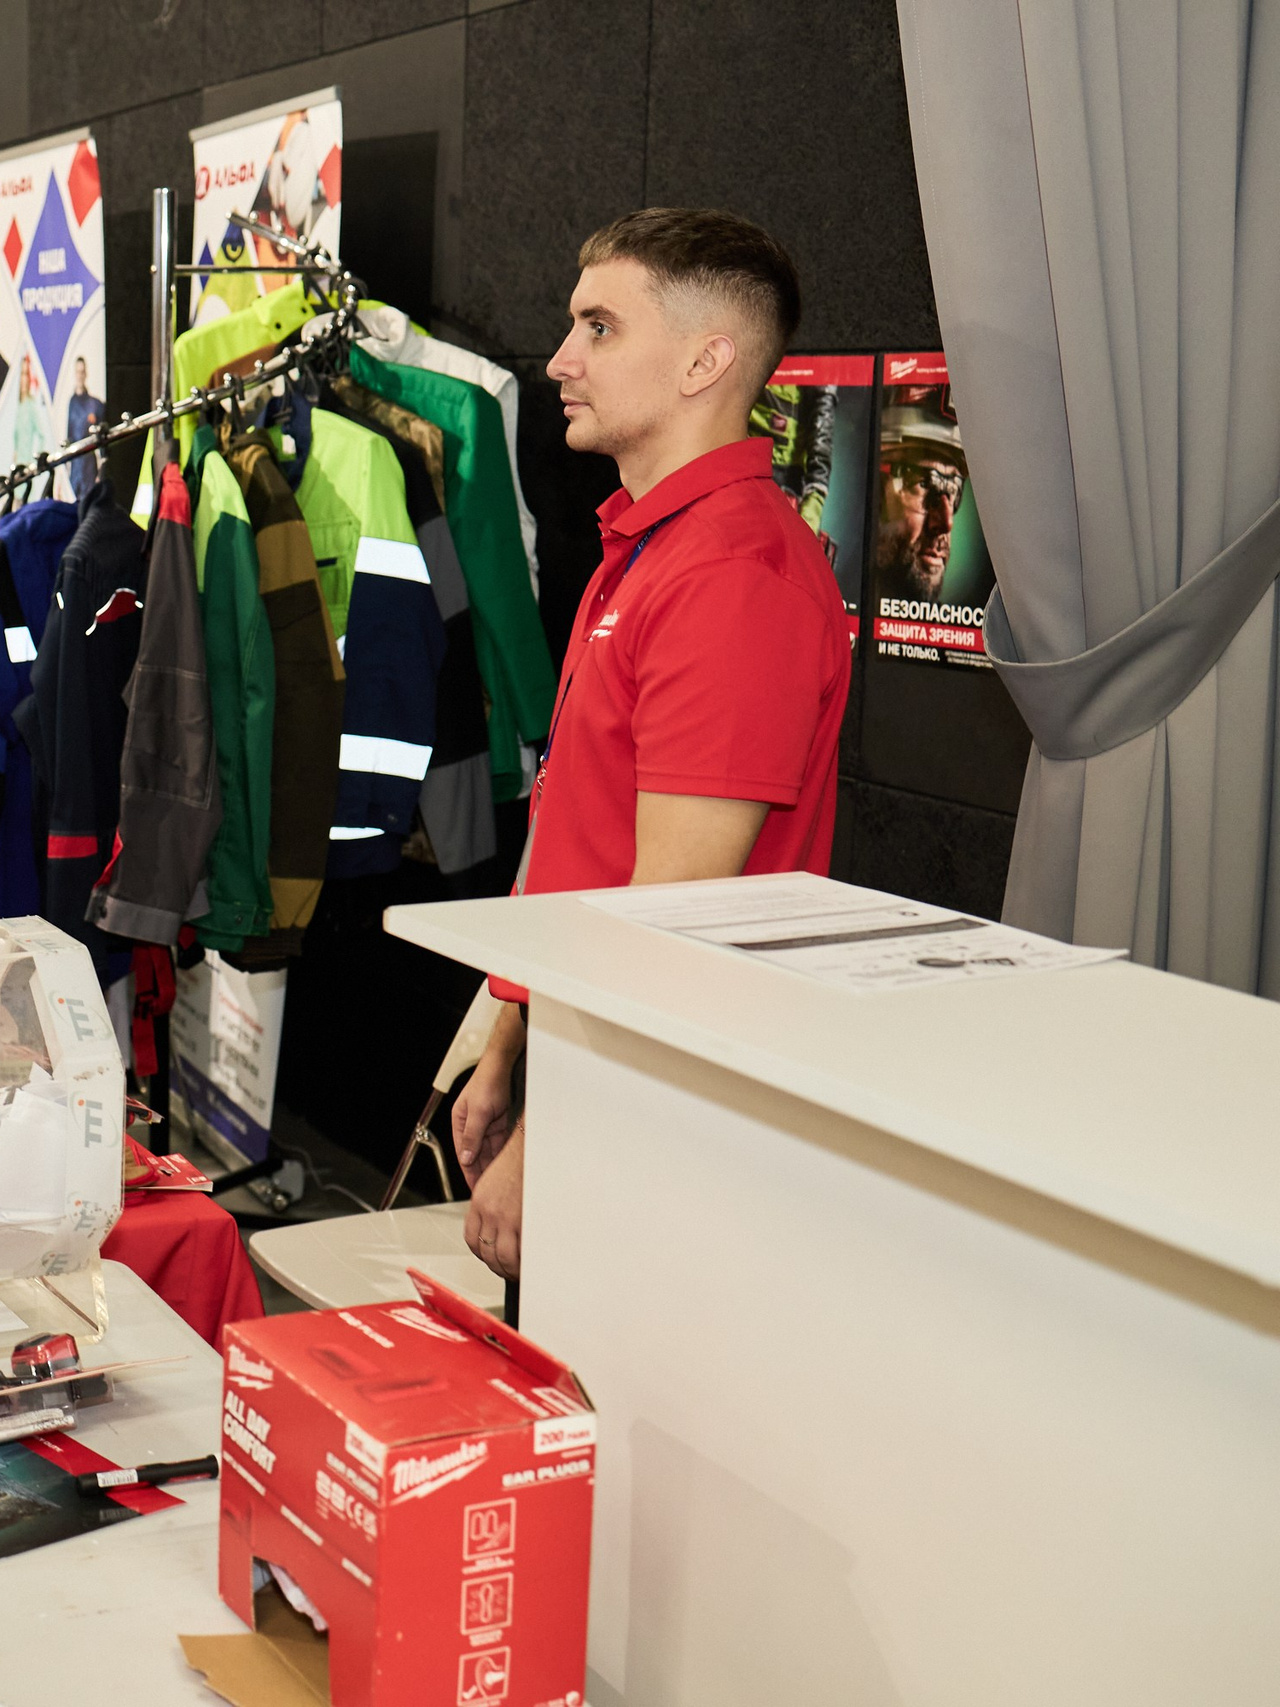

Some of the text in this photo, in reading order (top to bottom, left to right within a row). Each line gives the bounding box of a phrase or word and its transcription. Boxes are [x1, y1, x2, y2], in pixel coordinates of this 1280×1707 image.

[879, 598, 984, 627] БЕЗОПАСНОС
[879, 622, 975, 646] ЗАЩИТА ЗРЕНИЯ
[878, 642, 885, 654] И
[887, 643, 900, 656] НЕ
[901, 645, 941, 661] ТОЛЬКО.
[224, 1389, 271, 1443] ALL DAY
[223, 1413, 276, 1474] COMFORT
[539, 1430, 564, 1446] 200
[390, 1441, 488, 1494] Milwaukee
[502, 1459, 591, 1488] EAR PLUGS
